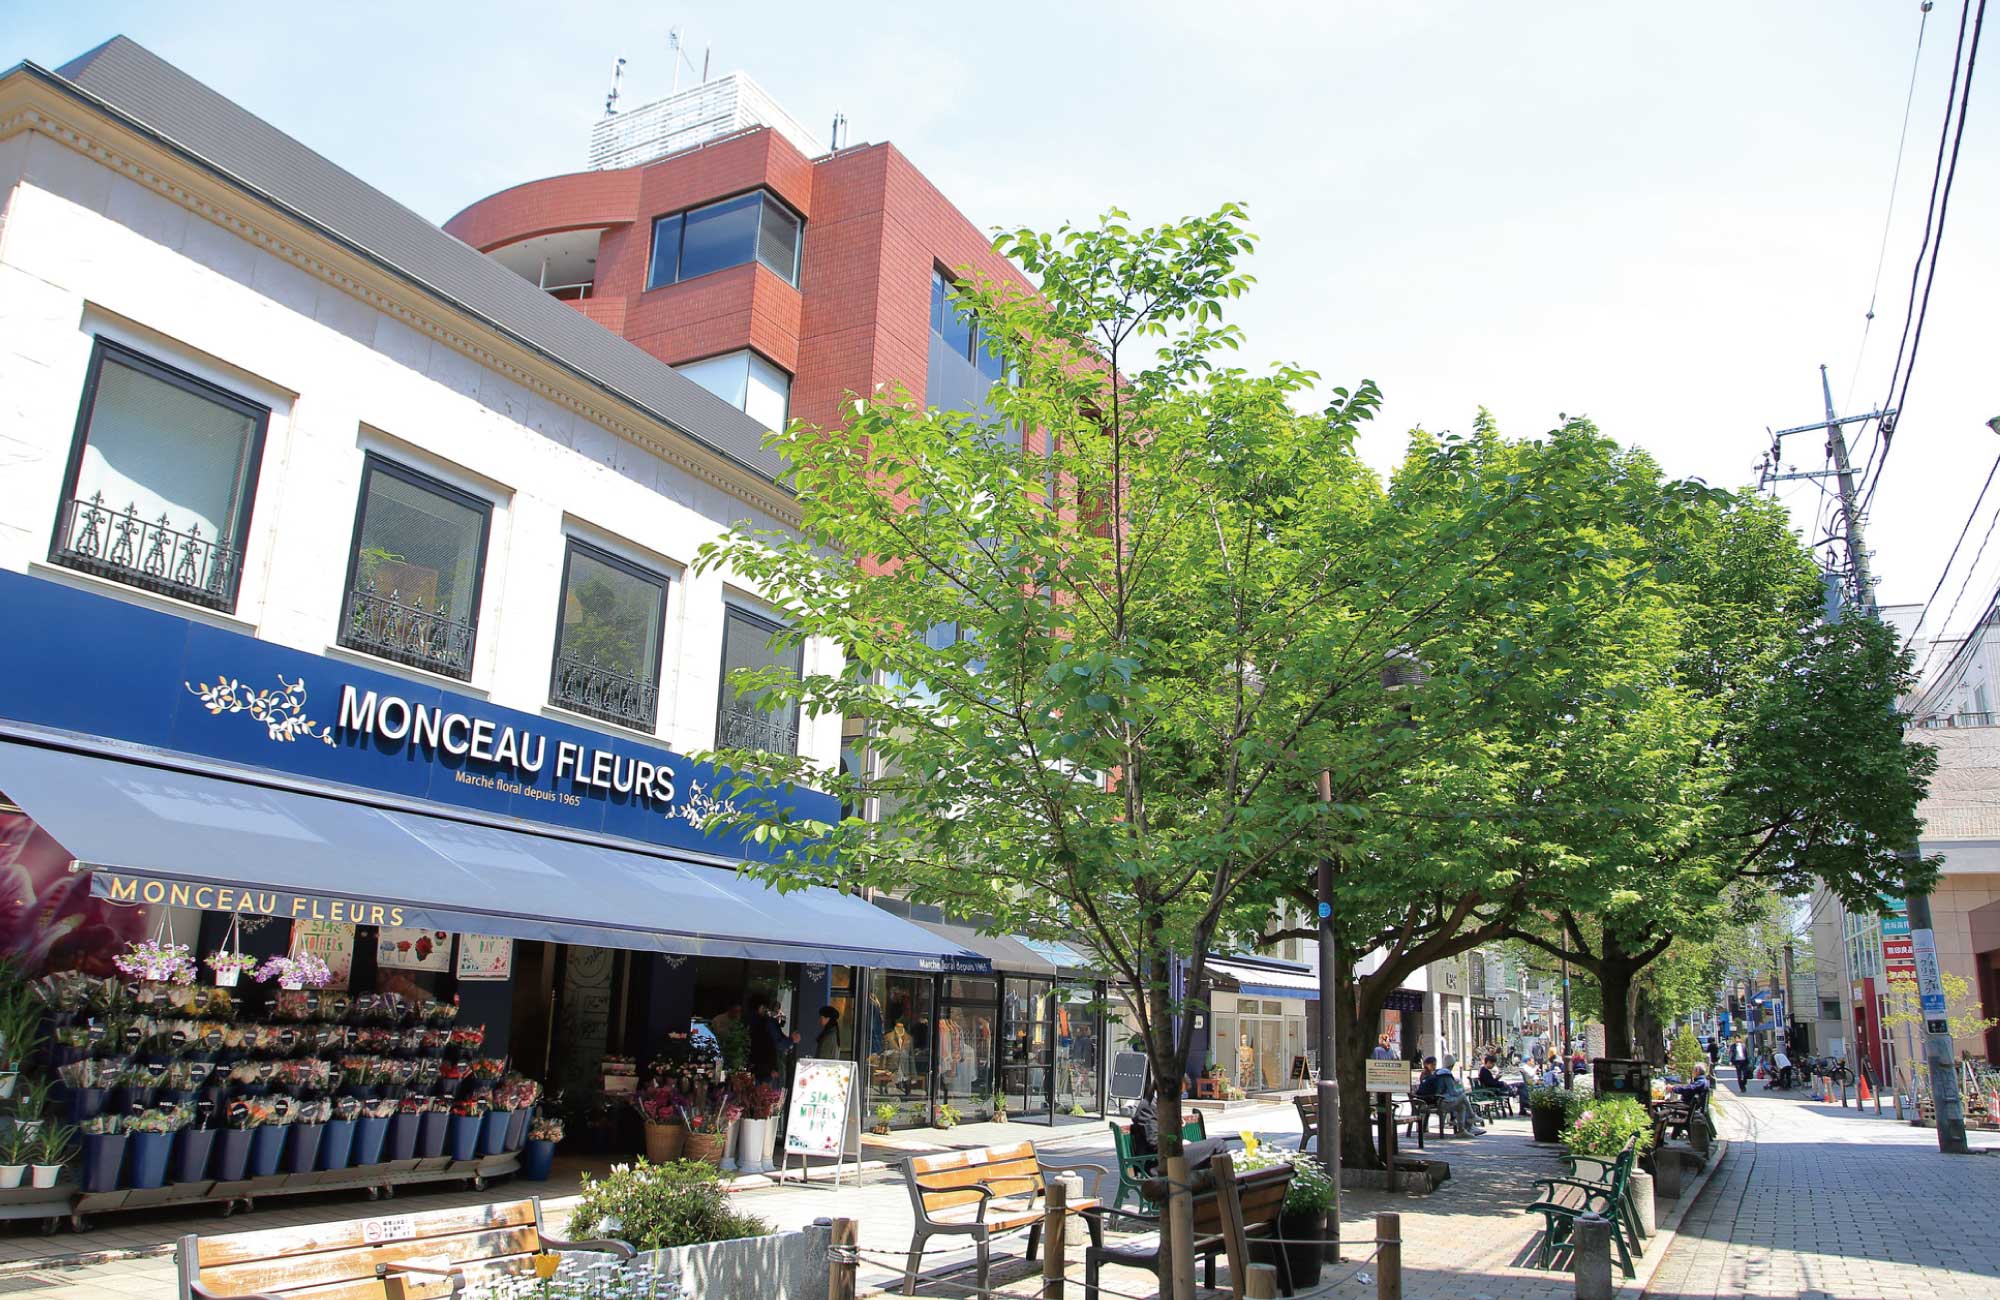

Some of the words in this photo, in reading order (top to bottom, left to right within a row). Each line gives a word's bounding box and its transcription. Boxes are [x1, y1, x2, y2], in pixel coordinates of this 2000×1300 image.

[338, 684, 545, 772] MONCEAU
[556, 740, 676, 802] FLEURS
[455, 770, 494, 789] Marché
[496, 779, 522, 795] floral
[524, 786, 556, 800] depuis
[559, 792, 581, 807] 1965
[110, 877, 277, 914] MONCEAU
[291, 897, 404, 926] FLEURS
